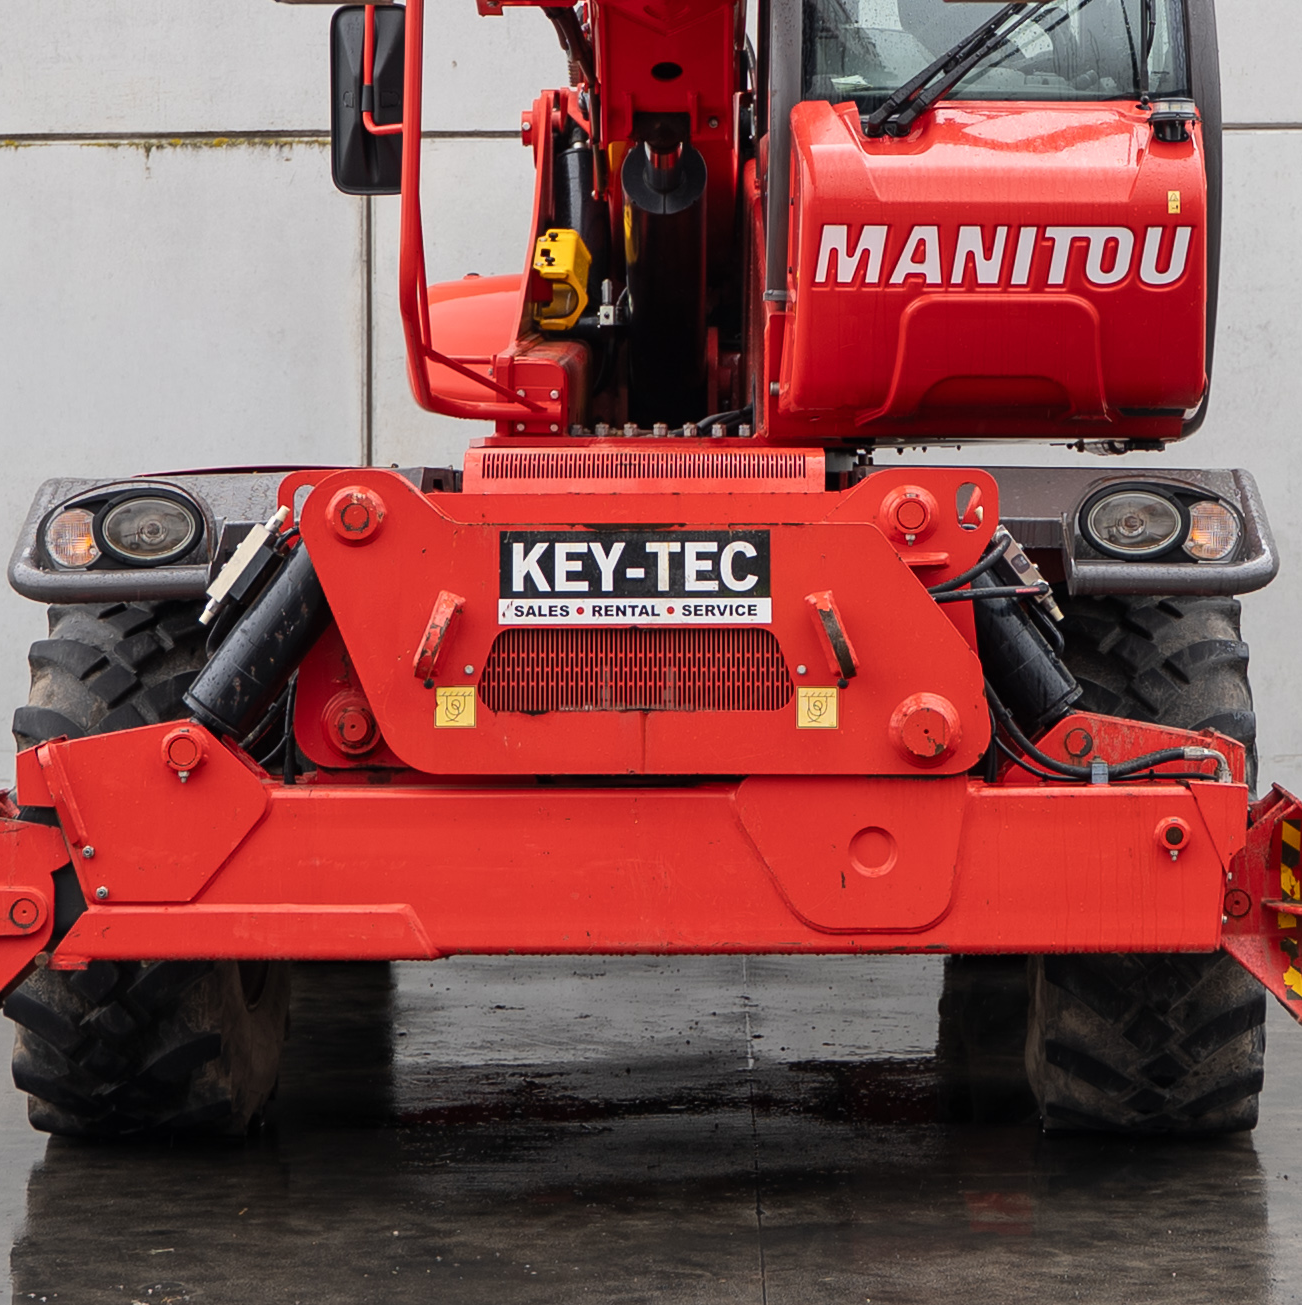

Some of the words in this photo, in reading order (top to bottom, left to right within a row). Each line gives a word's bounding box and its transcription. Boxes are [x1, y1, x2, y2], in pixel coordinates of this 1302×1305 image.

[813, 224, 1191, 285] MANITOU
[512, 541, 758, 592] KEY-TEC
[514, 604, 570, 617] SALES
[591, 604, 661, 617] RENTAL
[681, 604, 758, 617] SERVICE
